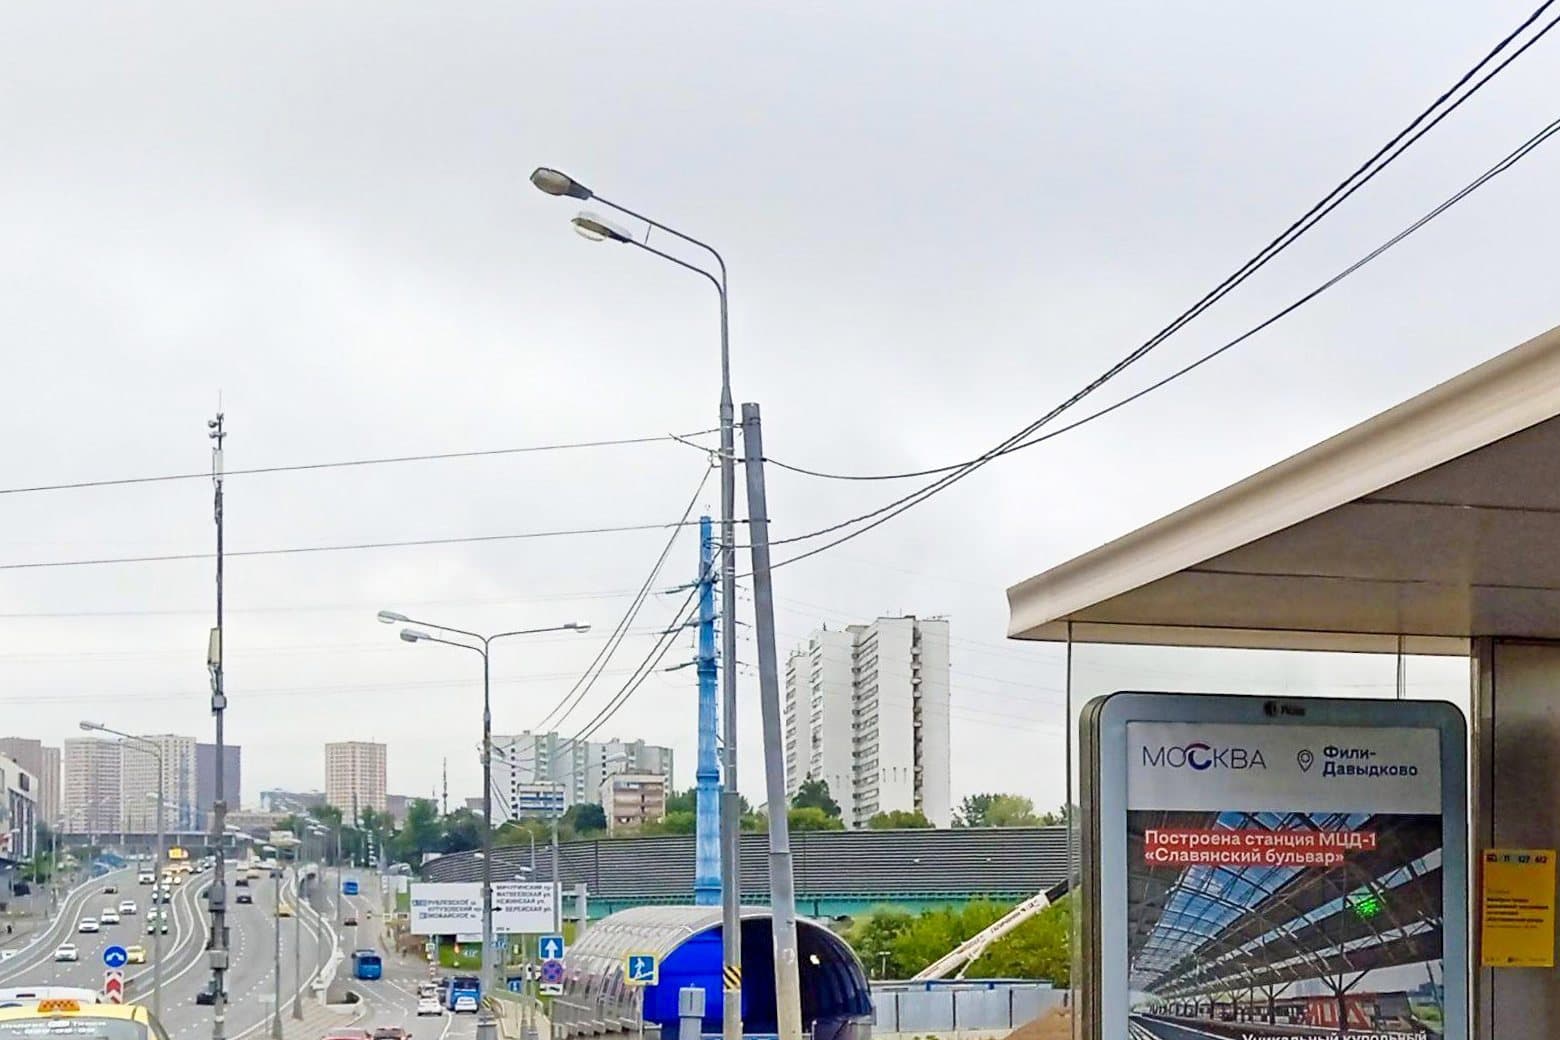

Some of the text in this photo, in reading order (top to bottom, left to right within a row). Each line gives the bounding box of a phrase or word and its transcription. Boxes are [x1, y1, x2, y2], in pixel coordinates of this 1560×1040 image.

[1142, 743, 1267, 770] МОСКВА
[1323, 746, 1376, 760] Фили-
[1322, 761, 1418, 777] Давыдково
[1145, 830, 1377, 849] Построена станция МЦД-1
[1144, 849, 1344, 866] «Славянский бульвар»
